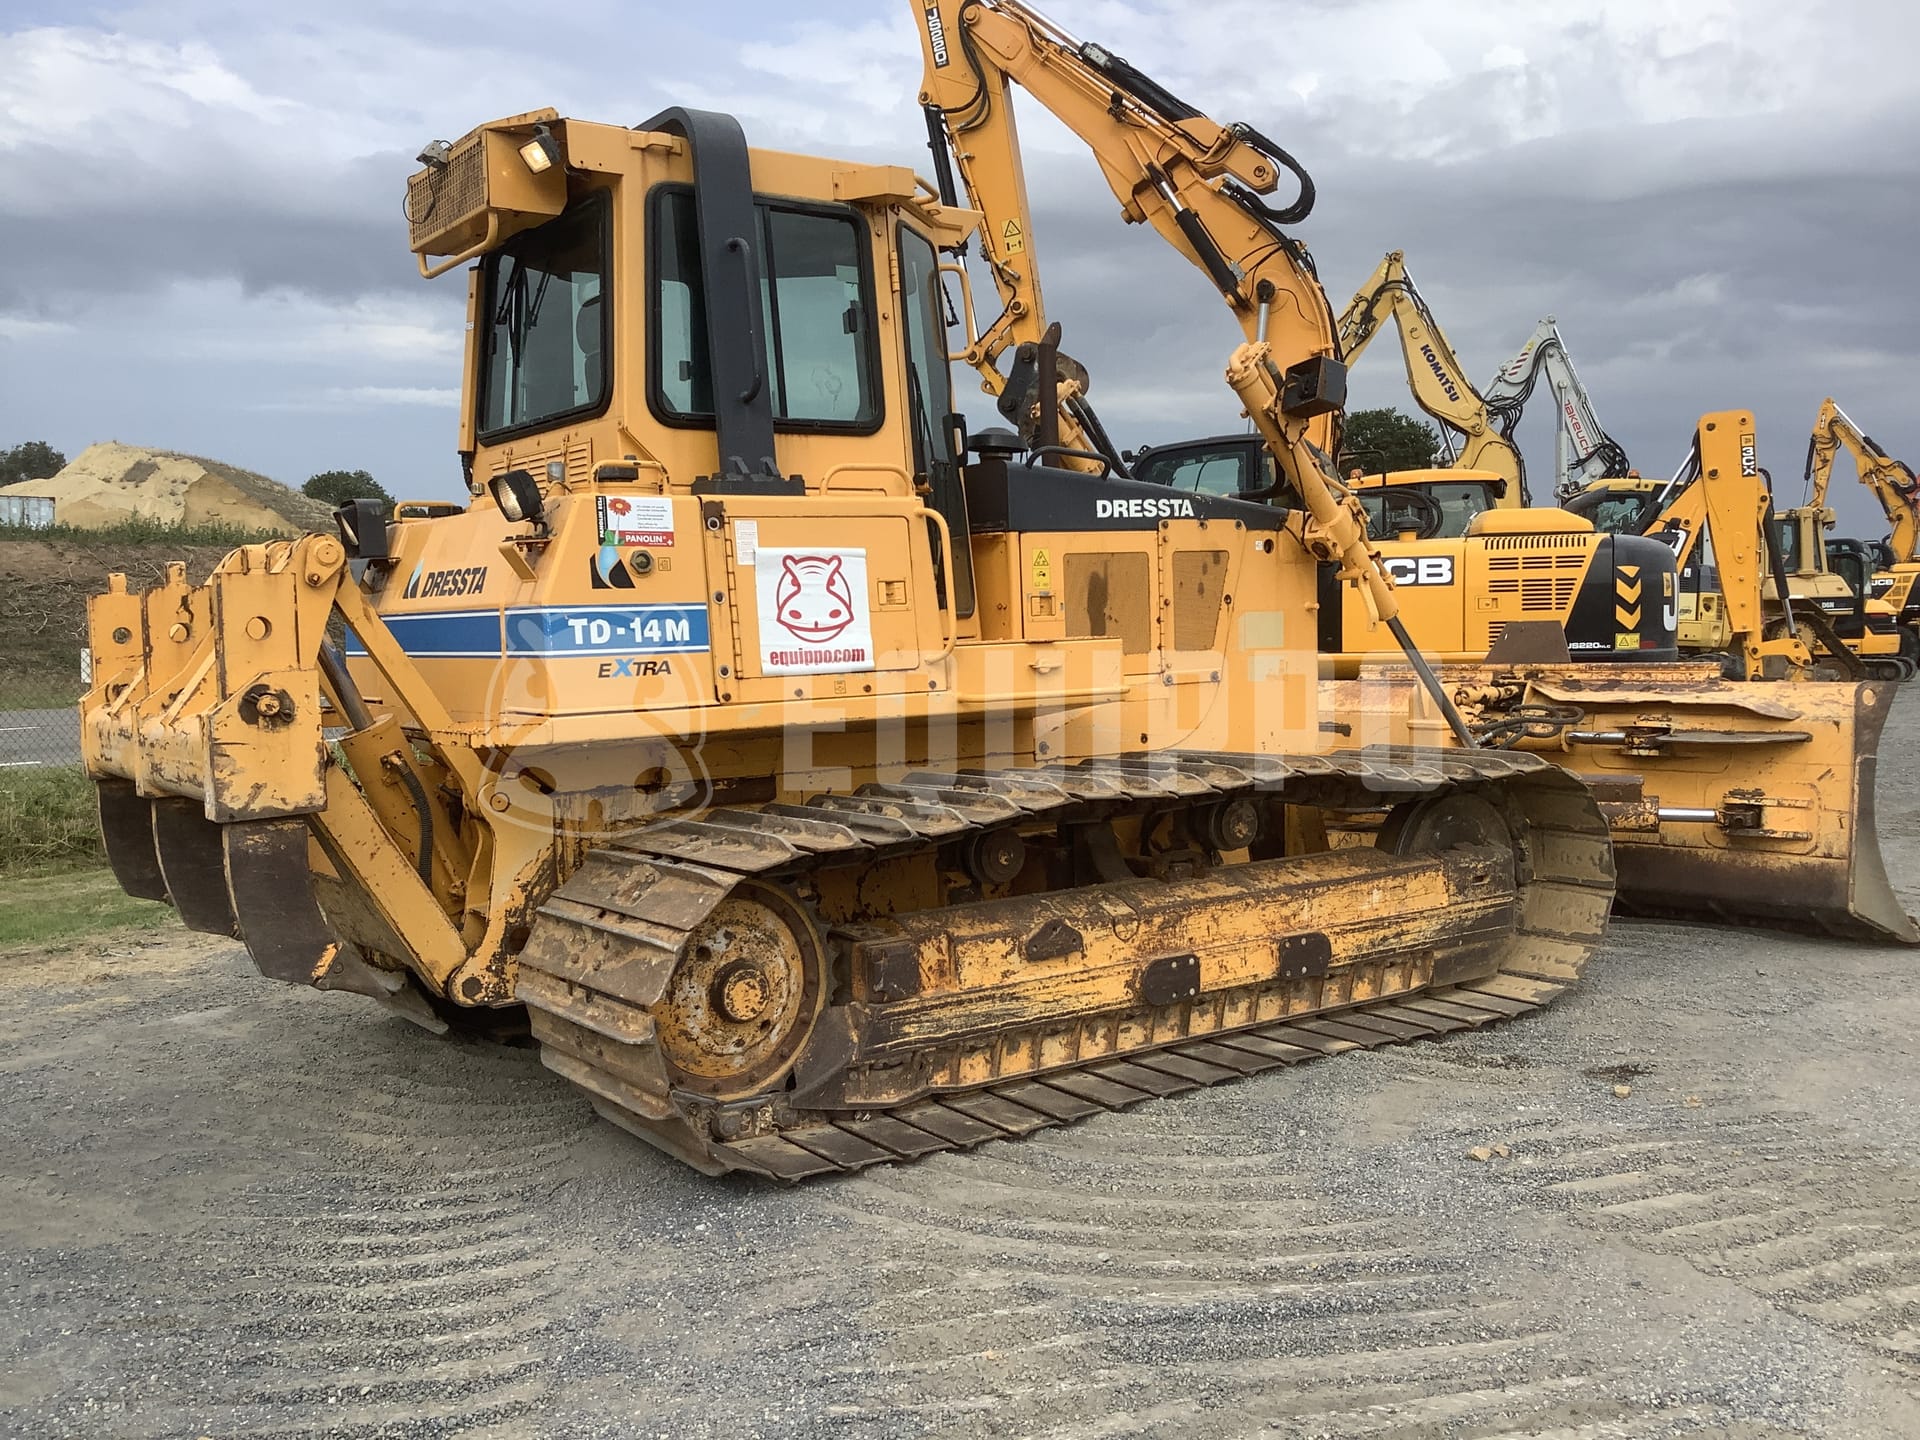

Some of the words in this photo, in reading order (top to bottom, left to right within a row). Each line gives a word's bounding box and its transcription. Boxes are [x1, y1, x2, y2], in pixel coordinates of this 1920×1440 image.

[927, 7, 948, 63] JS220
[1420, 343, 1460, 402] KOMATSU
[1742, 446, 1756, 476] 3CX
[1096, 498, 1194, 518] DRESSTA
[625, 534, 663, 543] PANOLIN
[420, 566, 488, 598] DRESSTA
[1383, 557, 1453, 585] CB
[598, 657, 672, 679] EXTRA
[769, 647, 866, 667] equippo.com
